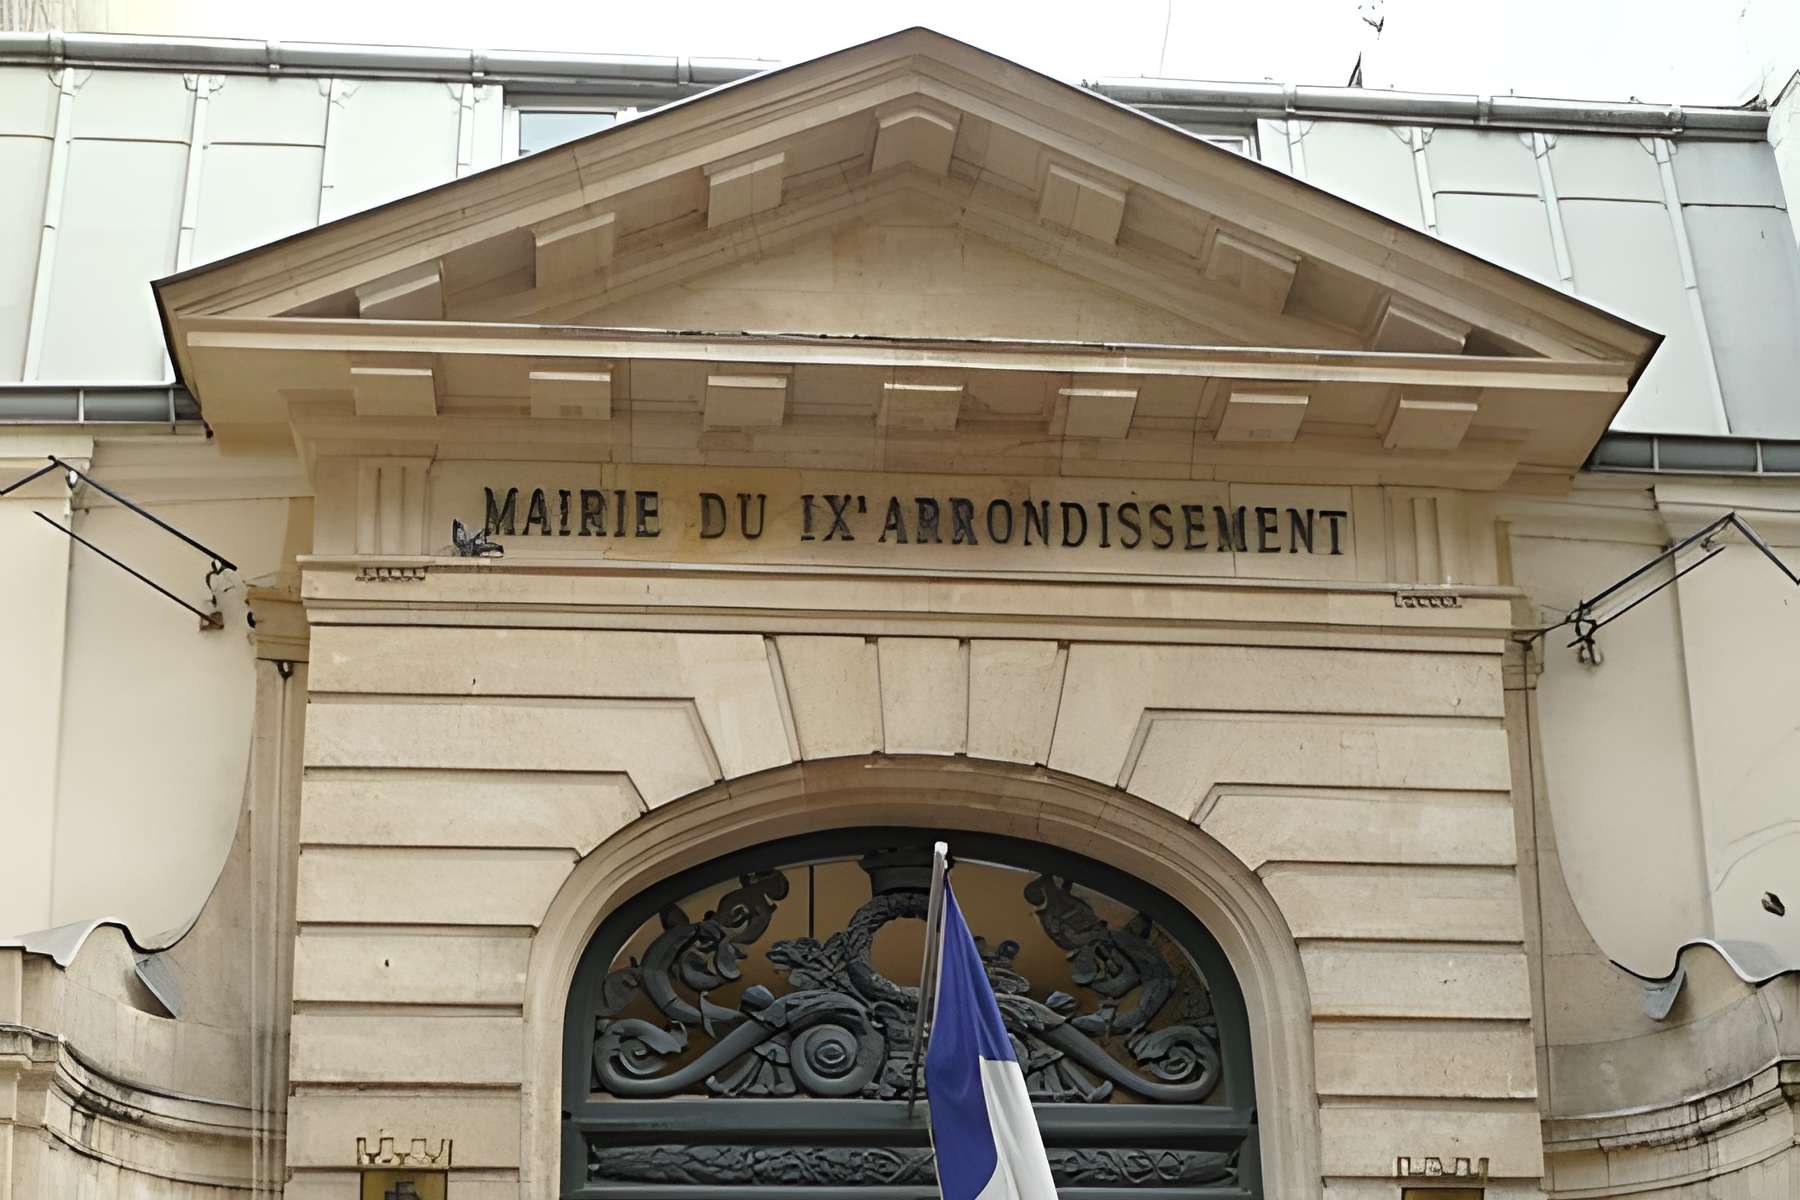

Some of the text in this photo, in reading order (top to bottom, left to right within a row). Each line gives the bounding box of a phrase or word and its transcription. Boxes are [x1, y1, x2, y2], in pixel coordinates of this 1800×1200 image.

[484, 486, 661, 539] MAIRIE
[699, 492, 767, 540] DU
[879, 496, 1349, 556] ARRONDISSEMENT
